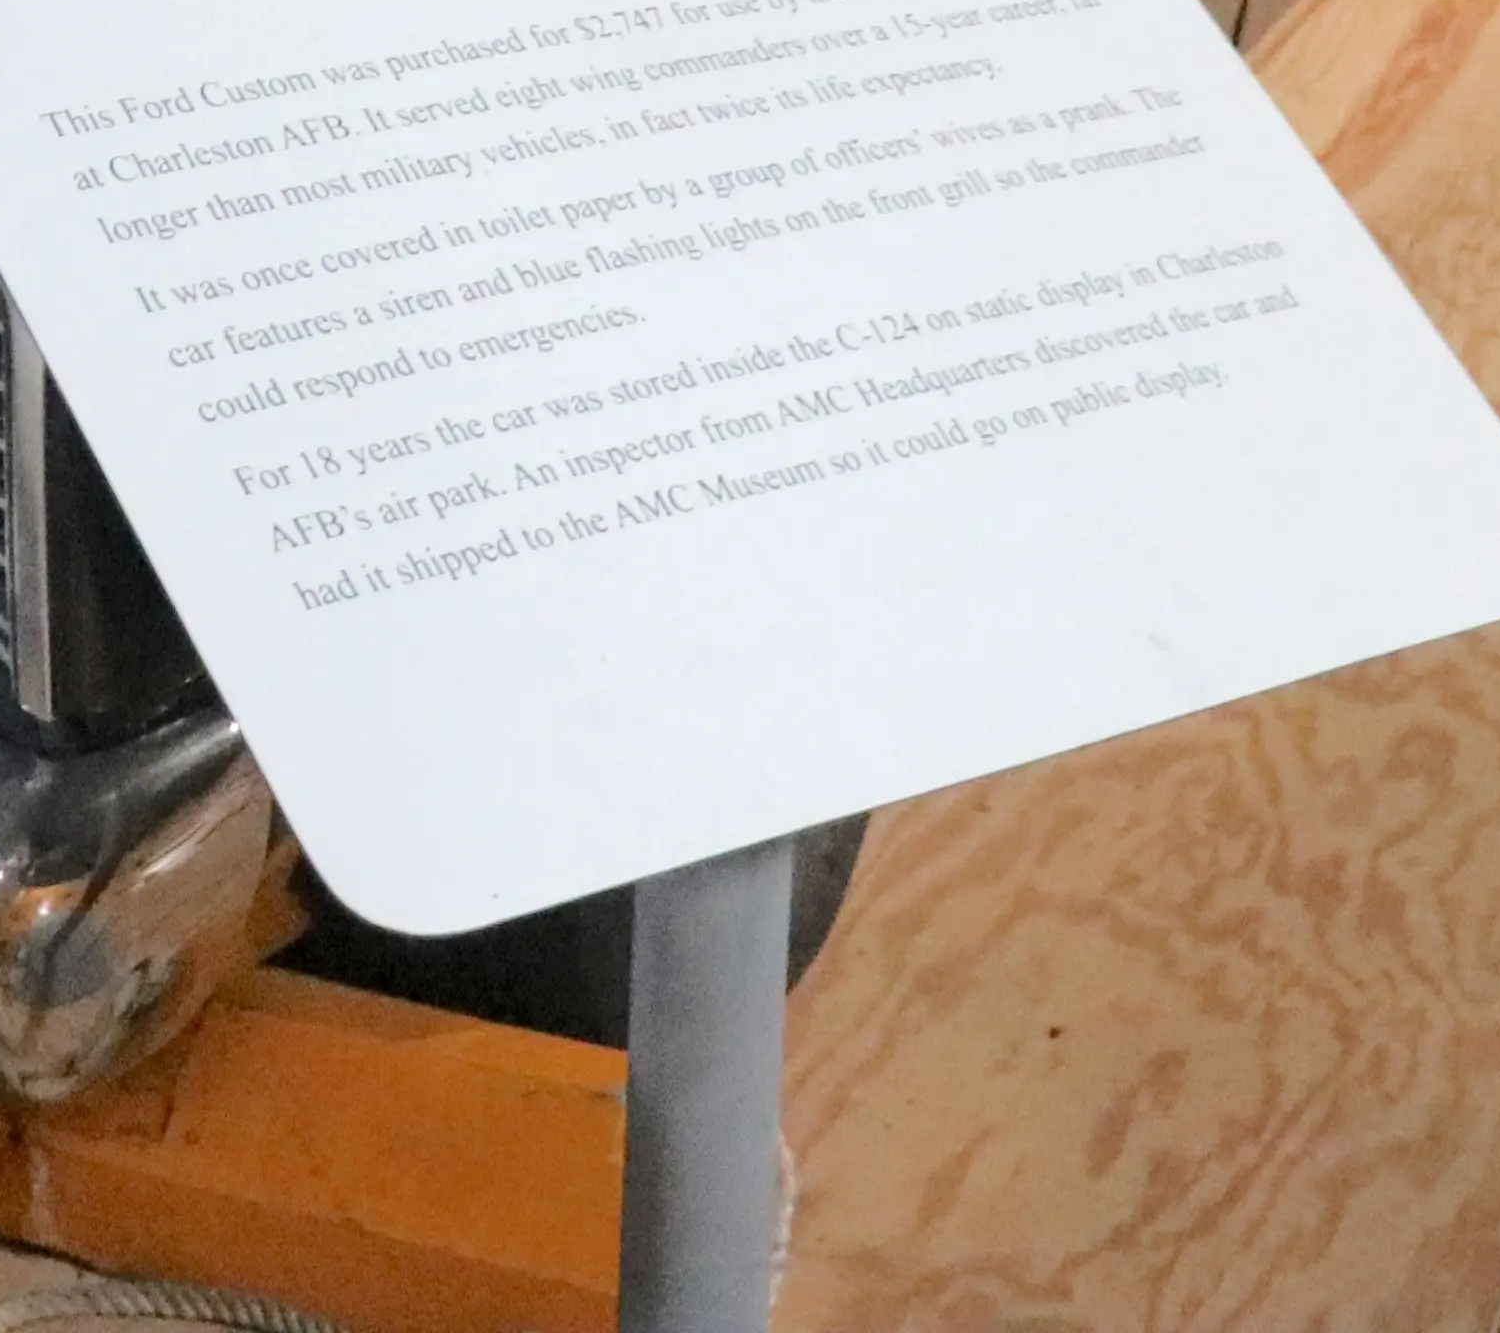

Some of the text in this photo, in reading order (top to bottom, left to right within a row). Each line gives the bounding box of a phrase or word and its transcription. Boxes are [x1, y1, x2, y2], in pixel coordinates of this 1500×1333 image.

[39, 104, 115, 137] This
[117, 86, 195, 123] Ford
[199, 72, 317, 107] Custom
[320, 61, 380, 84] was
[383, 28, 527, 81] purchased
[528, 24, 570, 48] for
[670, 1, 710, 24] for
[73, 166, 105, 190] at
[108, 136, 274, 182] Charleston
[282, 114, 360, 149] AFB.
[361, 107, 392, 132] It
[396, 86, 490, 126] served
[495, 76, 567, 110] eight
[568, 66, 642, 91] wing
[643, 37, 806, 80] commanders
[810, 28, 867, 51] over
[871, 25, 889, 41] a
[890, 9, 982, 38] 15-year
[96, 206, 198, 243] longer
[205, 192, 275, 221] than
[279, 173, 356, 206] most
[359, 152, 472, 189] military
[604, 116, 638, 140] in
[640, 108, 696, 134] fact
[696, 94, 770, 123] twice
[770, 87, 808, 109] its
[806, 76, 856, 103] life
[861, 58, 1000, 95] expectancy.
[134, 286, 166, 313] It
[170, 277, 234, 304] was
[241, 259, 313, 290] once
[320, 224, 439, 273] covered
[439, 221, 476, 247] in
[477, 205, 555, 238] toilet
[559, 190, 636, 229] paper
[638, 180, 677, 209] by
[684, 178, 704, 196] a
[708, 162, 785, 198] group
[790, 147, 819, 175] of
[929, 122, 1005, 147] wives
[1007, 118, 1036, 134] as
[1039, 112, 1057, 128] a
[1057, 94, 1131, 132] prank.
[1131, 87, 1181, 110] The
[168, 135, 1204, 367] car features a siren and blue flashing lights on the front grill so the commander
[197, 305, 646, 422] could respond to emergencies.
[232, 240, 1284, 495] For 18 years the car was stored inside the C-124 on static display in Charleston
[378, 491, 419, 524] air
[426, 472, 507, 519] park.
[514, 462, 559, 491] An
[559, 429, 695, 477] inspector
[700, 412, 772, 443] from
[777, 385, 852, 426] AMC
[853, 351, 1031, 406] Headquarters
[1034, 312, 1169, 363] discovered
[1168, 308, 1210, 332] the
[1213, 300, 1250, 323] car
[1254, 285, 1299, 314] and
[292, 362, 1228, 610] had it shipped to the AMC Museum so it could go on public display.
